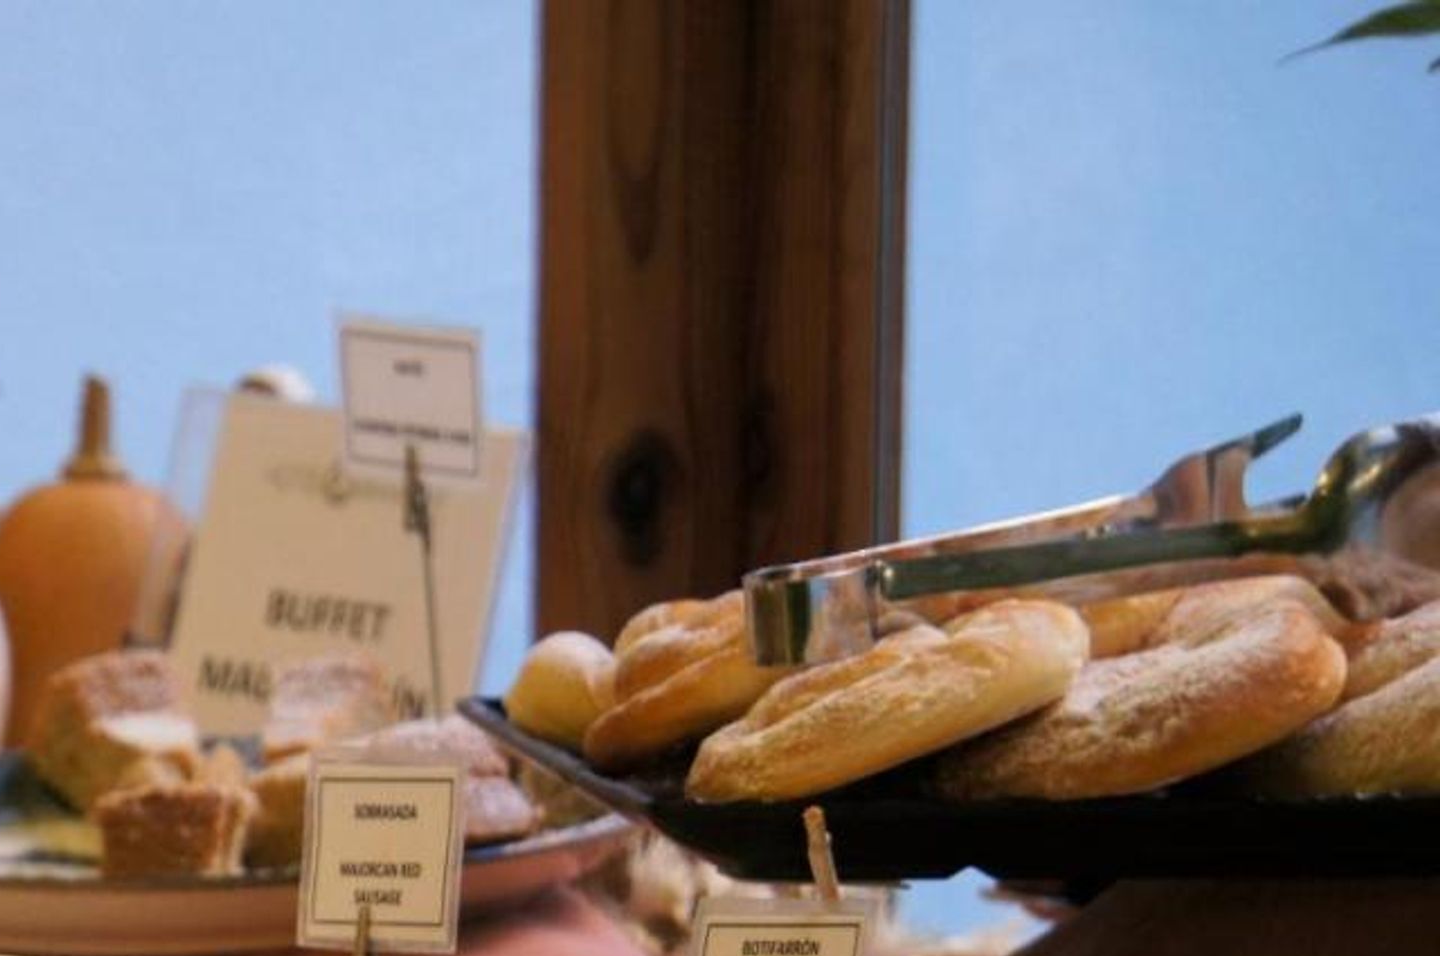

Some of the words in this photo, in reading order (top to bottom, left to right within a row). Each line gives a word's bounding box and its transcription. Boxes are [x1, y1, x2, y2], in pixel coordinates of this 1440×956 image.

[265, 588, 392, 641] BUFFET
[354, 803, 418, 820] SOBRASADA
[339, 862, 398, 878] MAJORCAN
[401, 862, 422, 879] RED
[742, 938, 821, 956] BOTIFARRÓN
